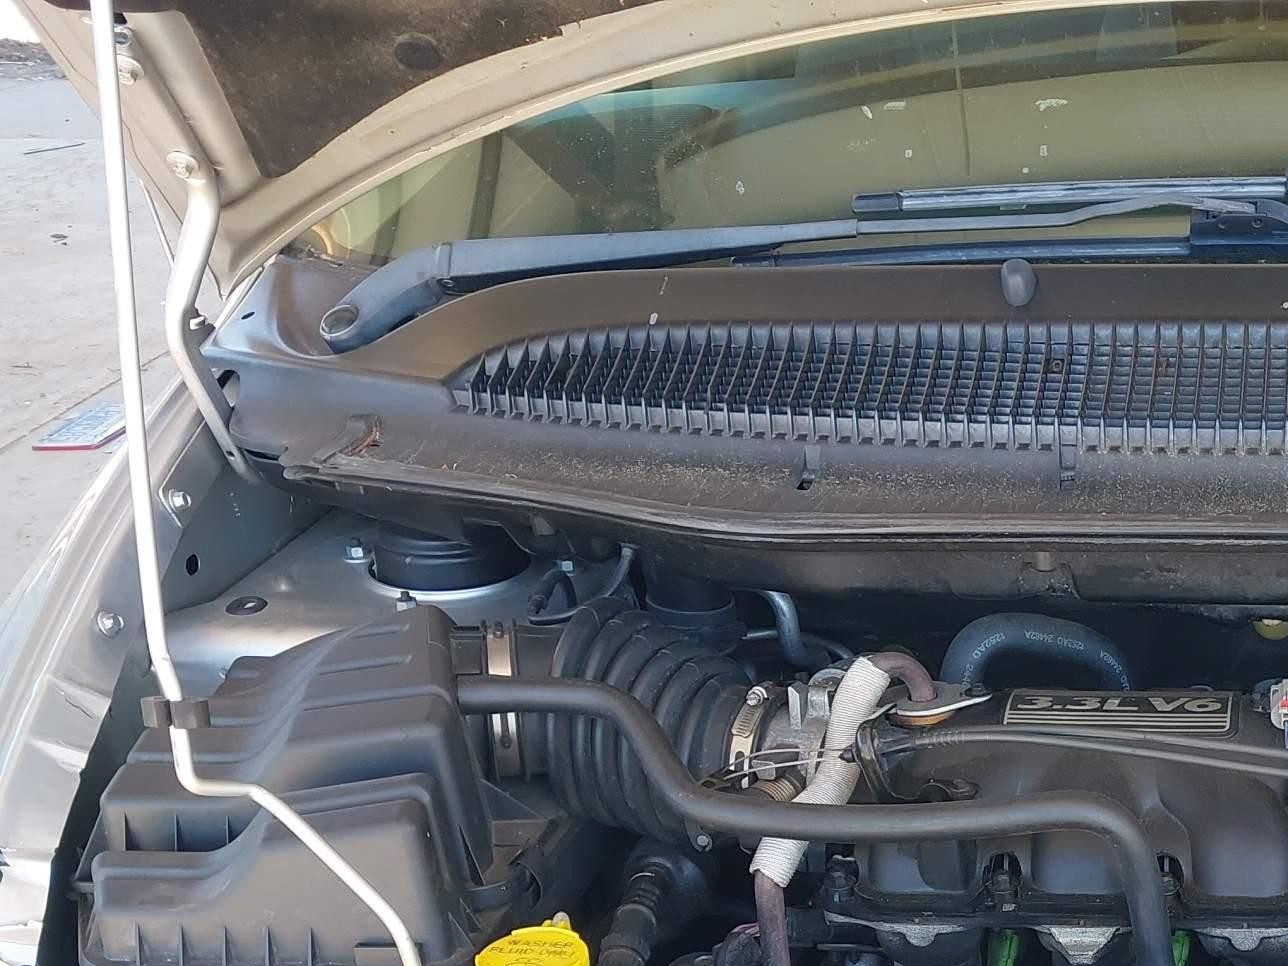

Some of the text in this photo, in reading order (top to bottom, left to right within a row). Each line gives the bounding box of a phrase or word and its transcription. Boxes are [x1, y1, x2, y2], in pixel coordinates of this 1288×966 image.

[1017, 696, 1222, 712] 3.3L V6
[508, 940, 574, 948] WASHER
[490, 946, 536, 954] FLUID
